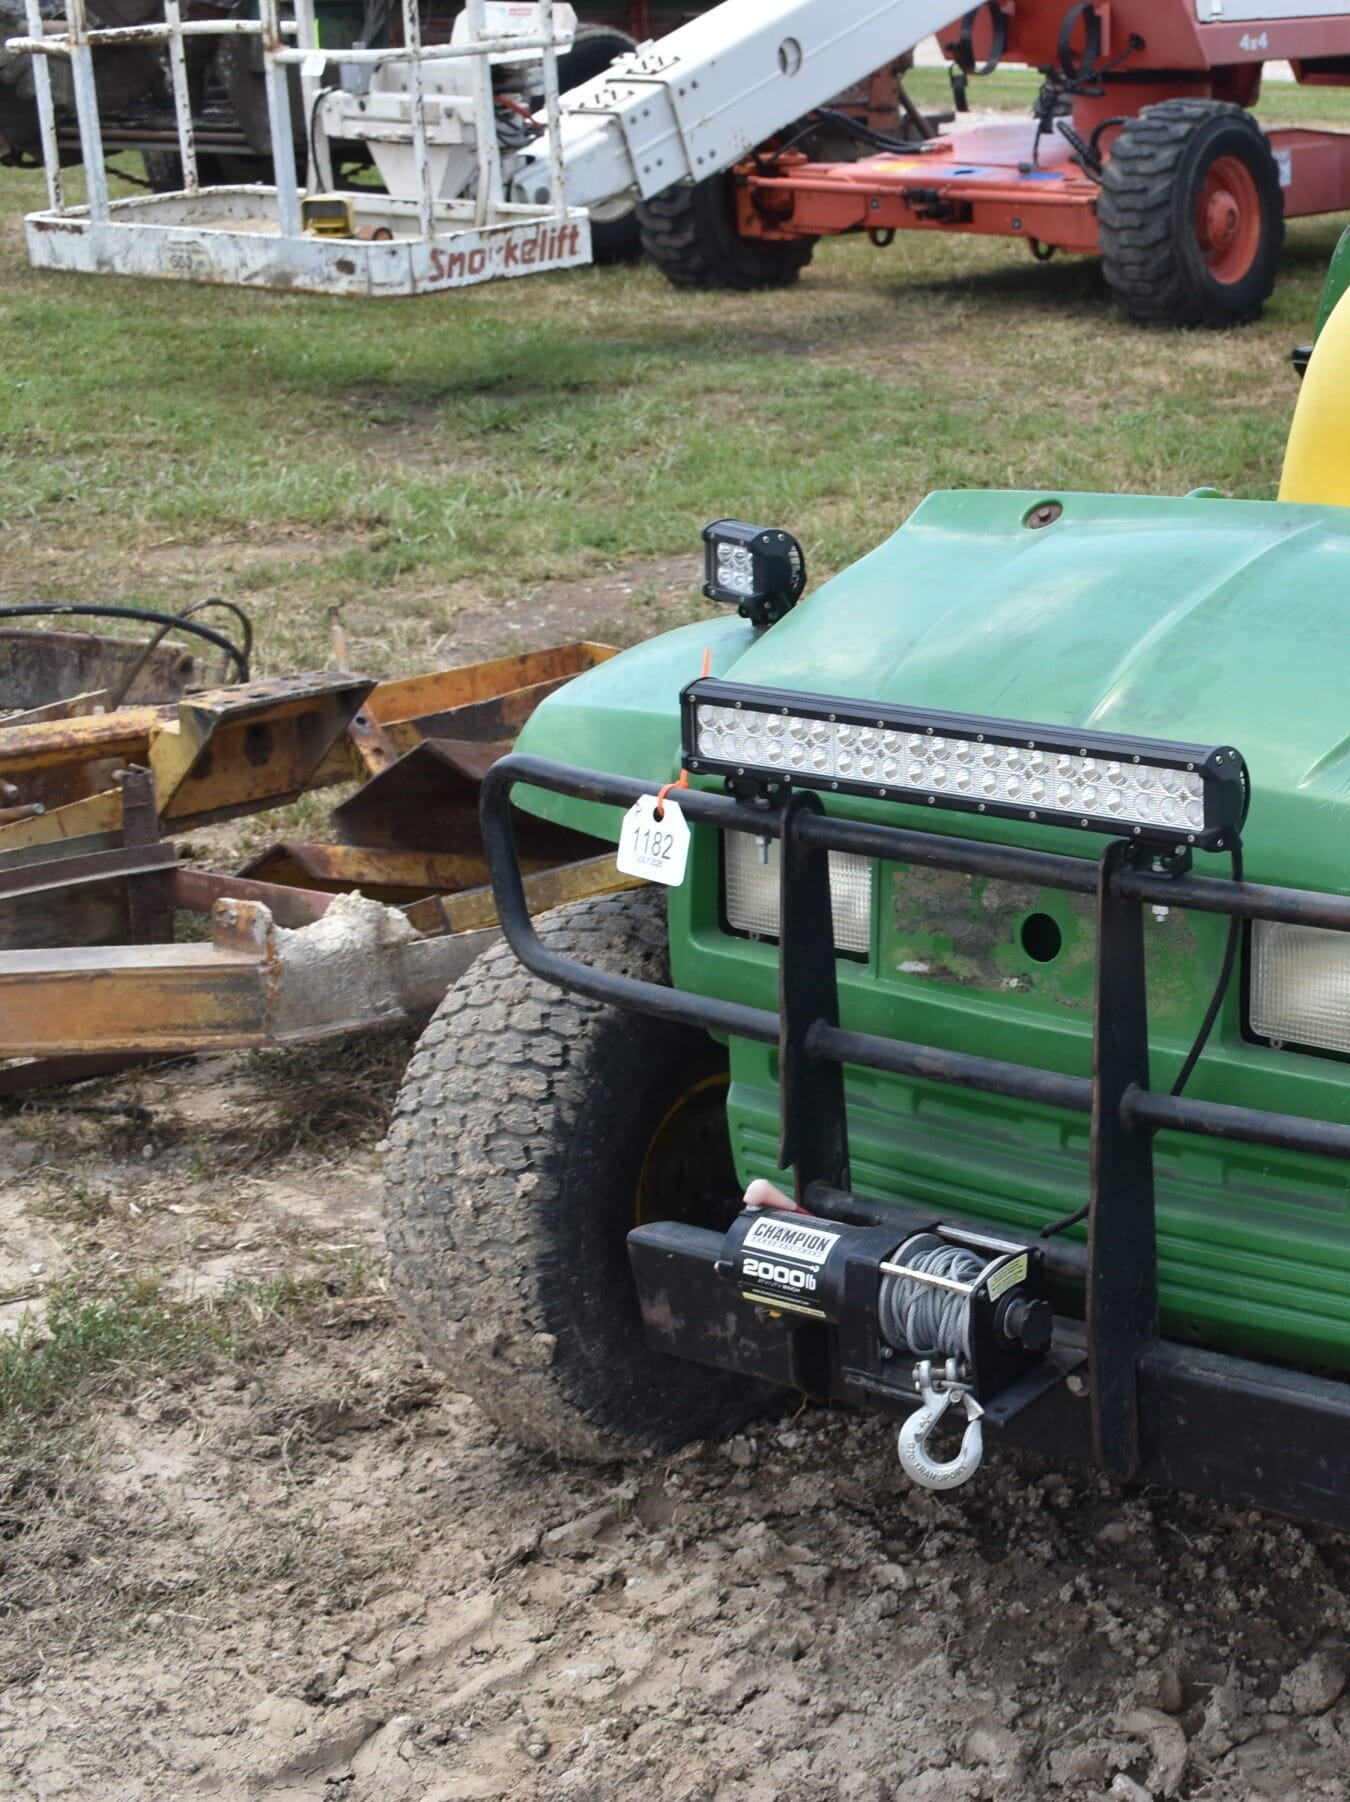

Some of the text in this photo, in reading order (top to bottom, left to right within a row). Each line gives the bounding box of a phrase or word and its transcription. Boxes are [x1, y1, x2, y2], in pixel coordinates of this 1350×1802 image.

[1239, 32, 1268, 50] 4x4
[633, 826, 674, 860] 1182
[754, 1223, 830, 1252] CHAMPION
[743, 1258, 816, 1291] 2000lb
